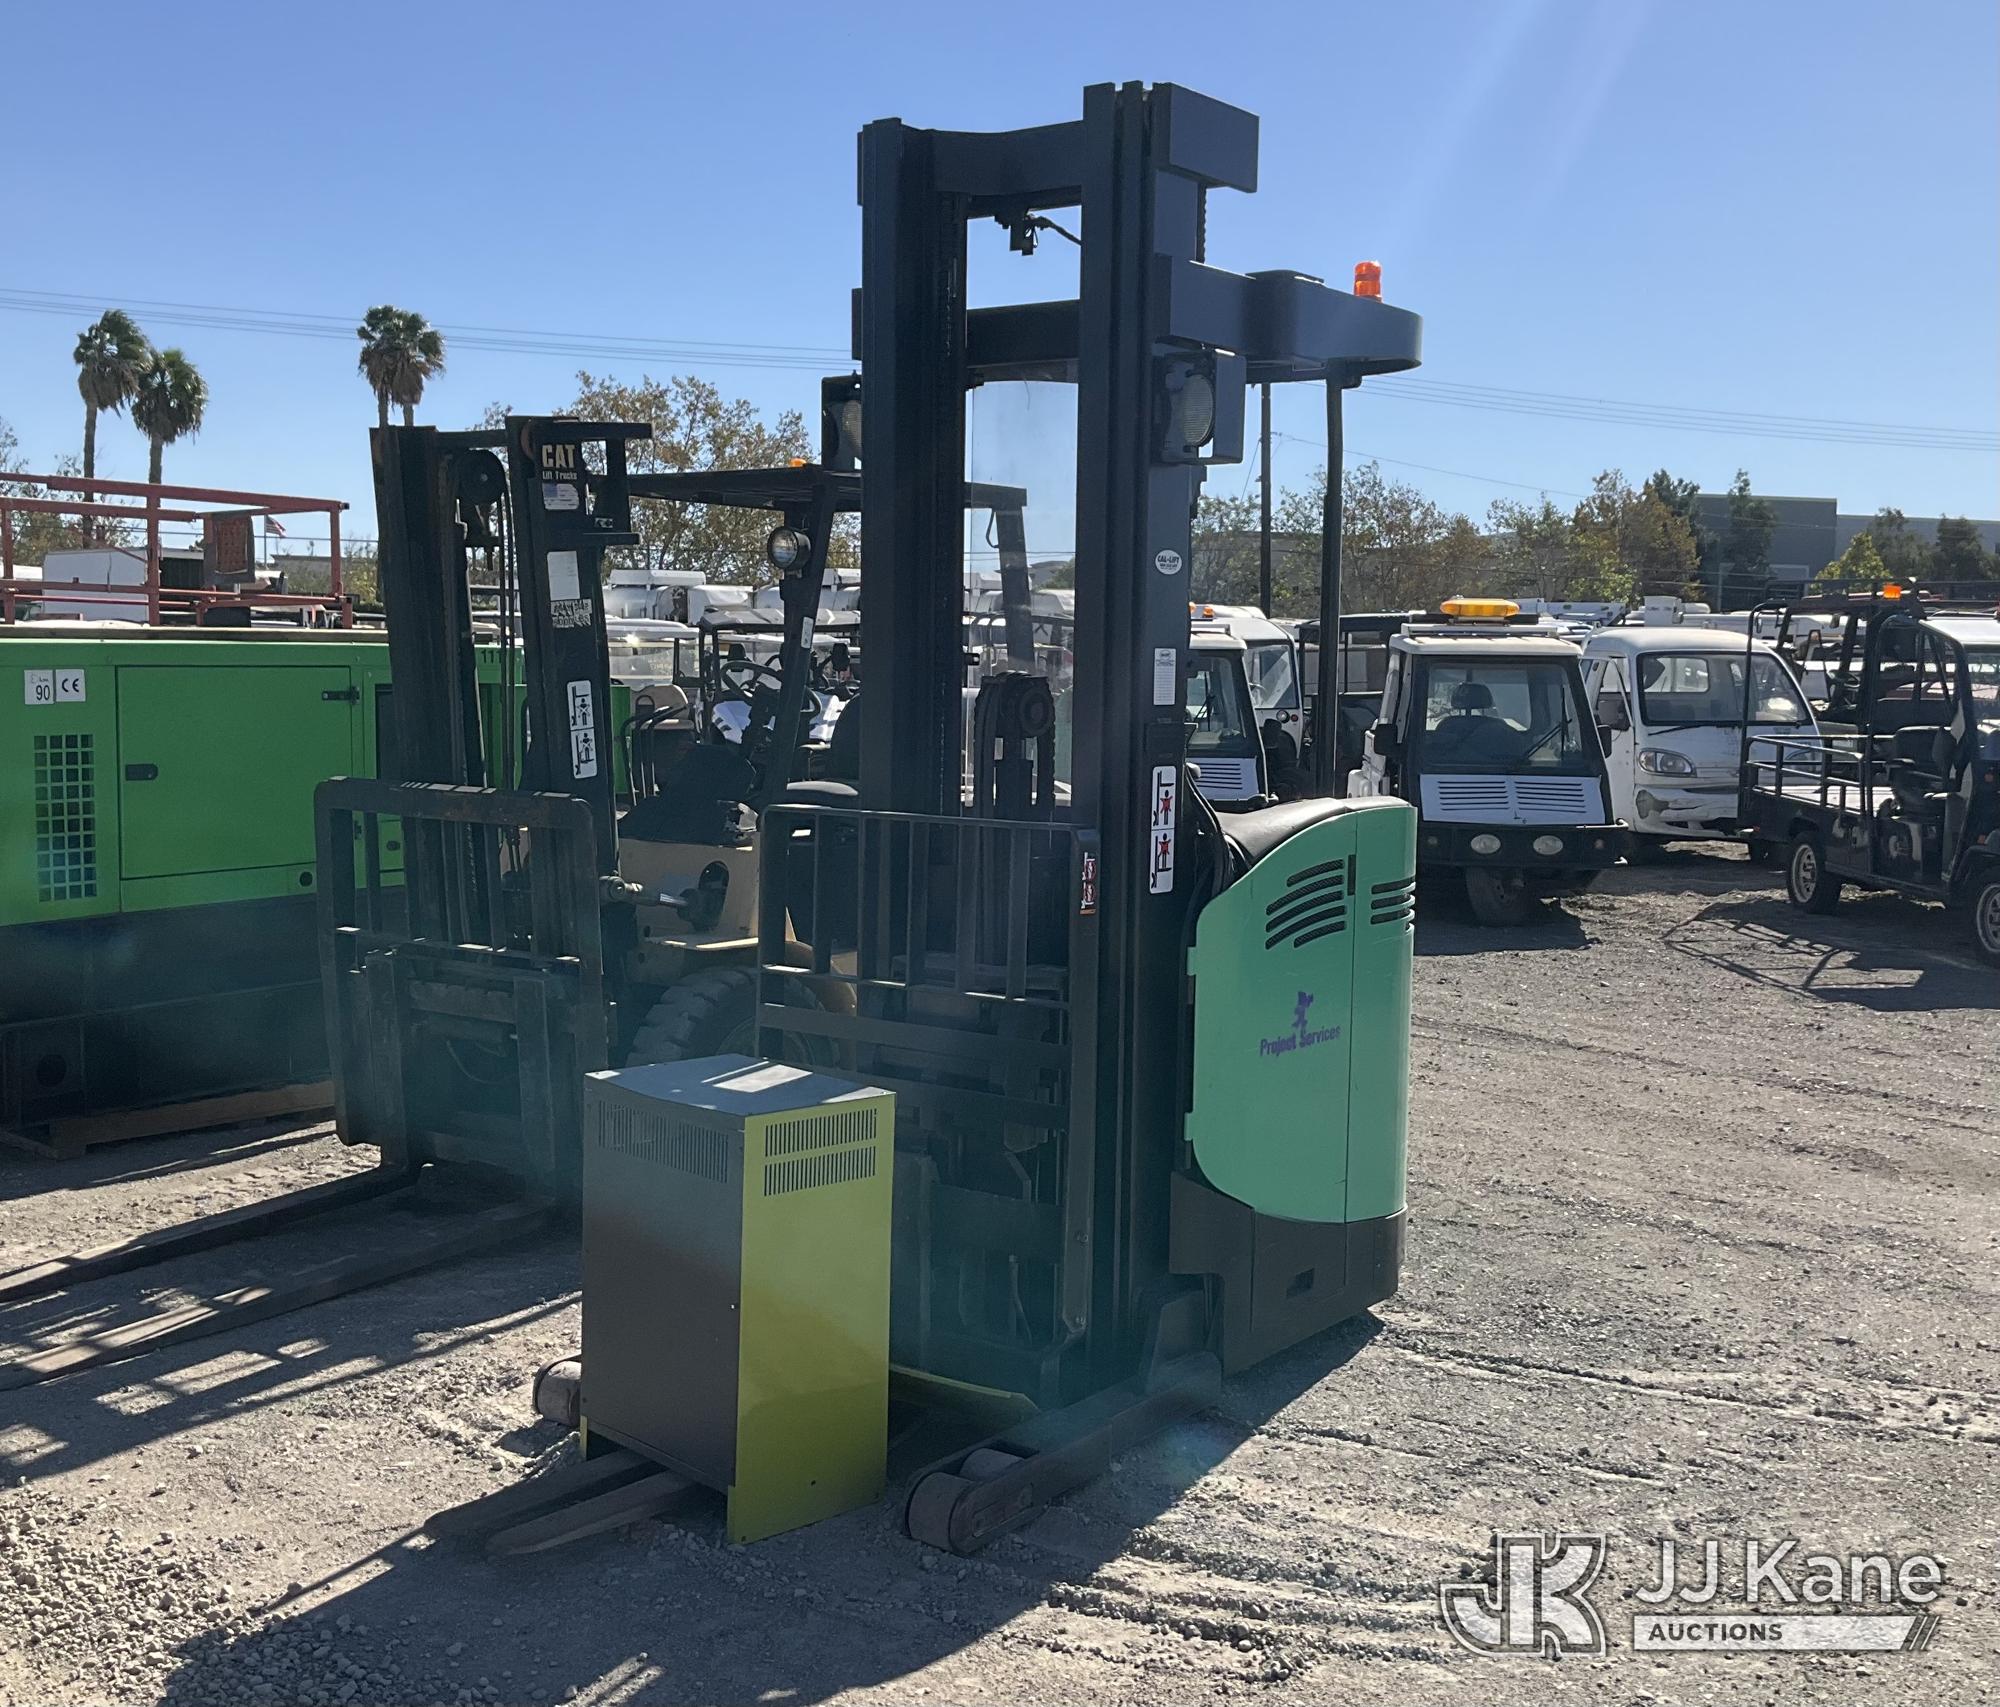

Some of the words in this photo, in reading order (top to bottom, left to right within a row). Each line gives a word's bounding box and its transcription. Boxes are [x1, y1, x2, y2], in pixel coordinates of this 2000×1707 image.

[542, 444, 575, 468] CAT
[36, 685, 51, 701] 90
[61, 678, 80, 693] CE
[1260, 1032, 1296, 1056] Project
[1298, 1025, 1341, 1048] Services
